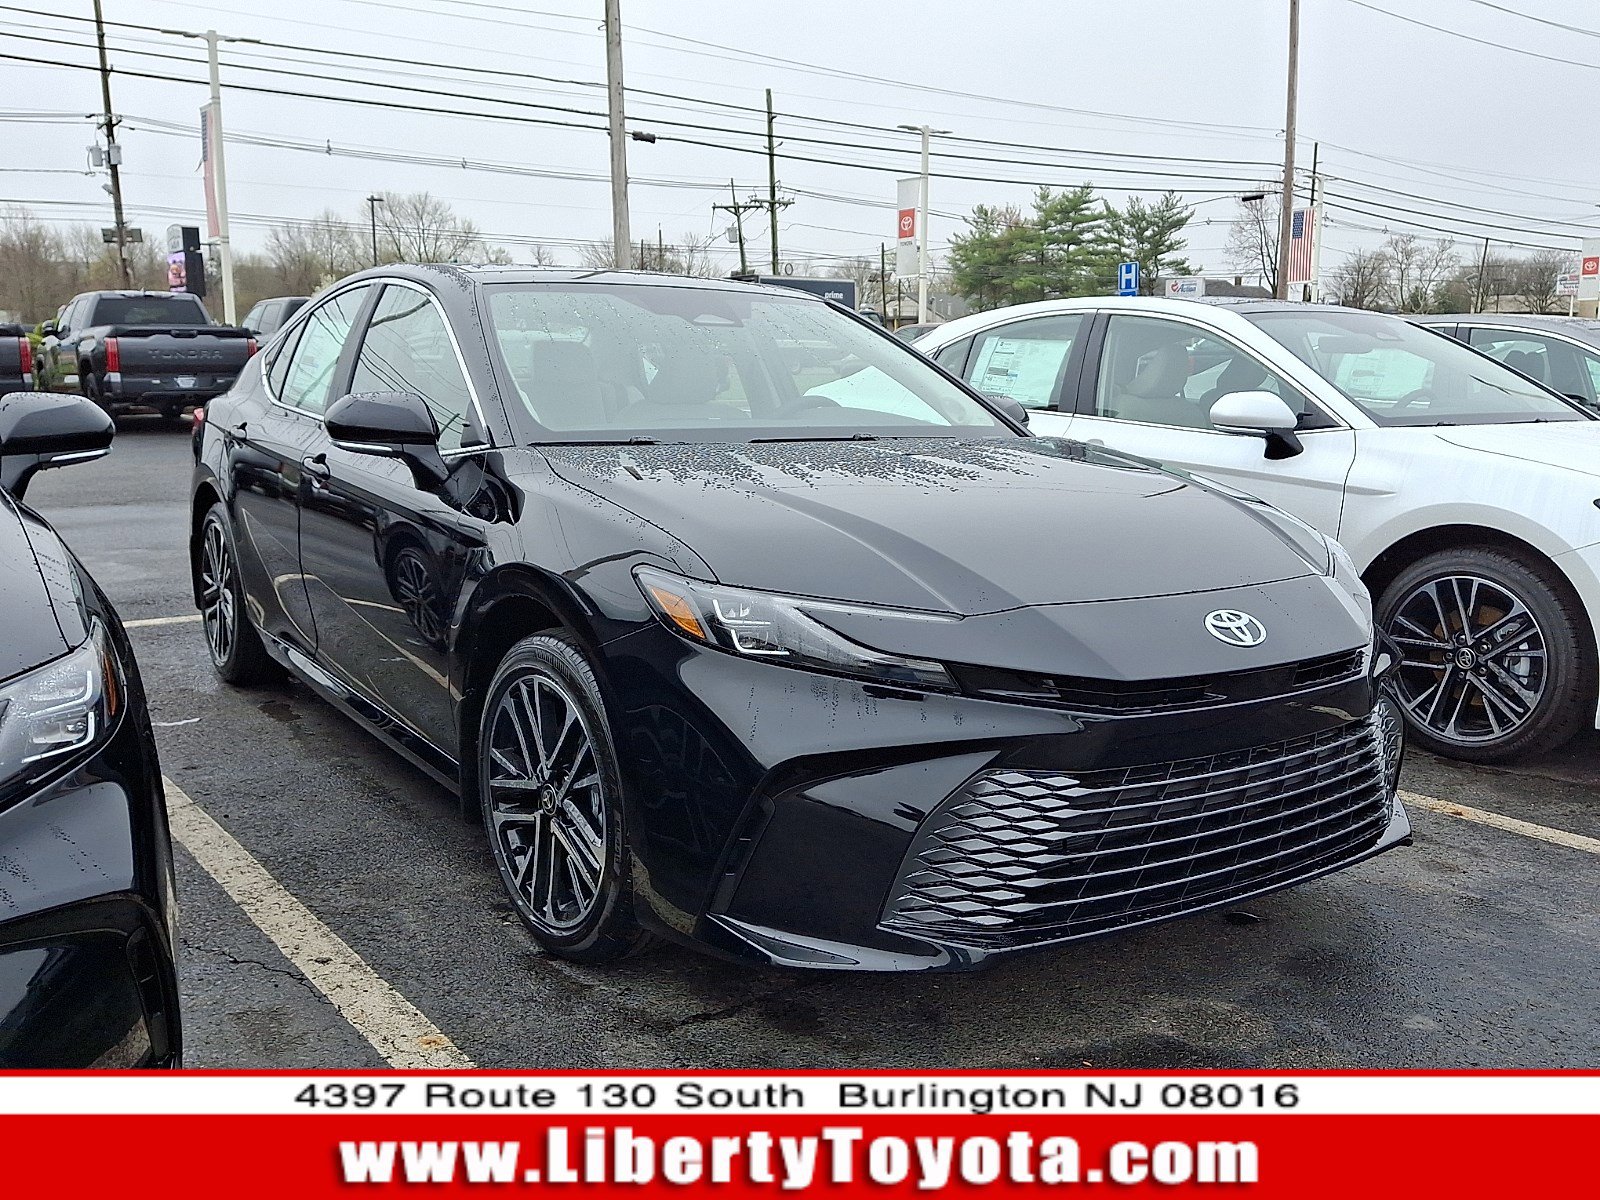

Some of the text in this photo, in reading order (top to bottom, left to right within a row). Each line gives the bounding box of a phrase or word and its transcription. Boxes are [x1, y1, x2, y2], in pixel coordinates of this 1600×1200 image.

[1121, 264, 1136, 289] H
[825, 291, 844, 300] prime
[148, 349, 223, 359] TUNDRA
